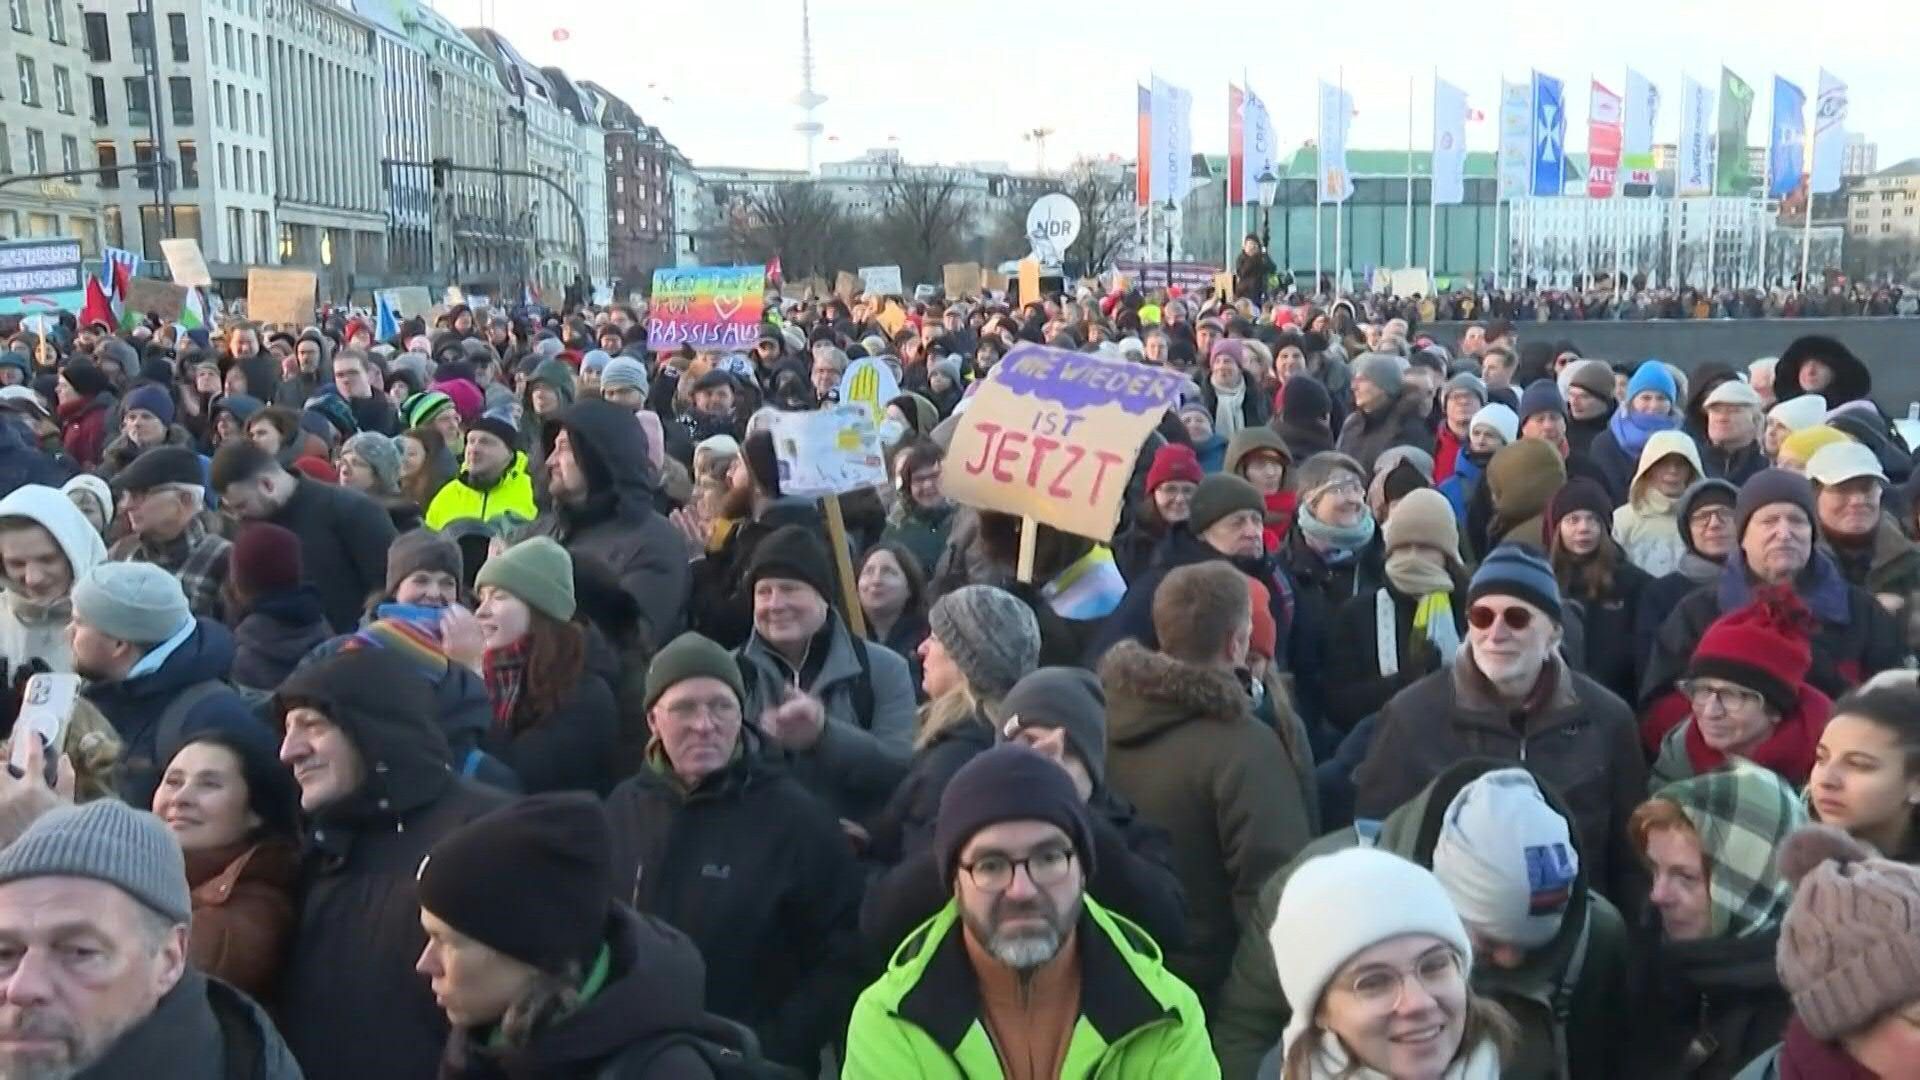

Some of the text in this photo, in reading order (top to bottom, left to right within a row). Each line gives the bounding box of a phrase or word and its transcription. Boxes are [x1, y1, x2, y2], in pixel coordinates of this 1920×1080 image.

[1036, 220, 1072, 238] NDR
[650, 318, 760, 345] RASSISMUS
[1059, 361, 1176, 399] WIEDER
[1031, 411, 1086, 436] IST
[965, 422, 1123, 506] JETZT
